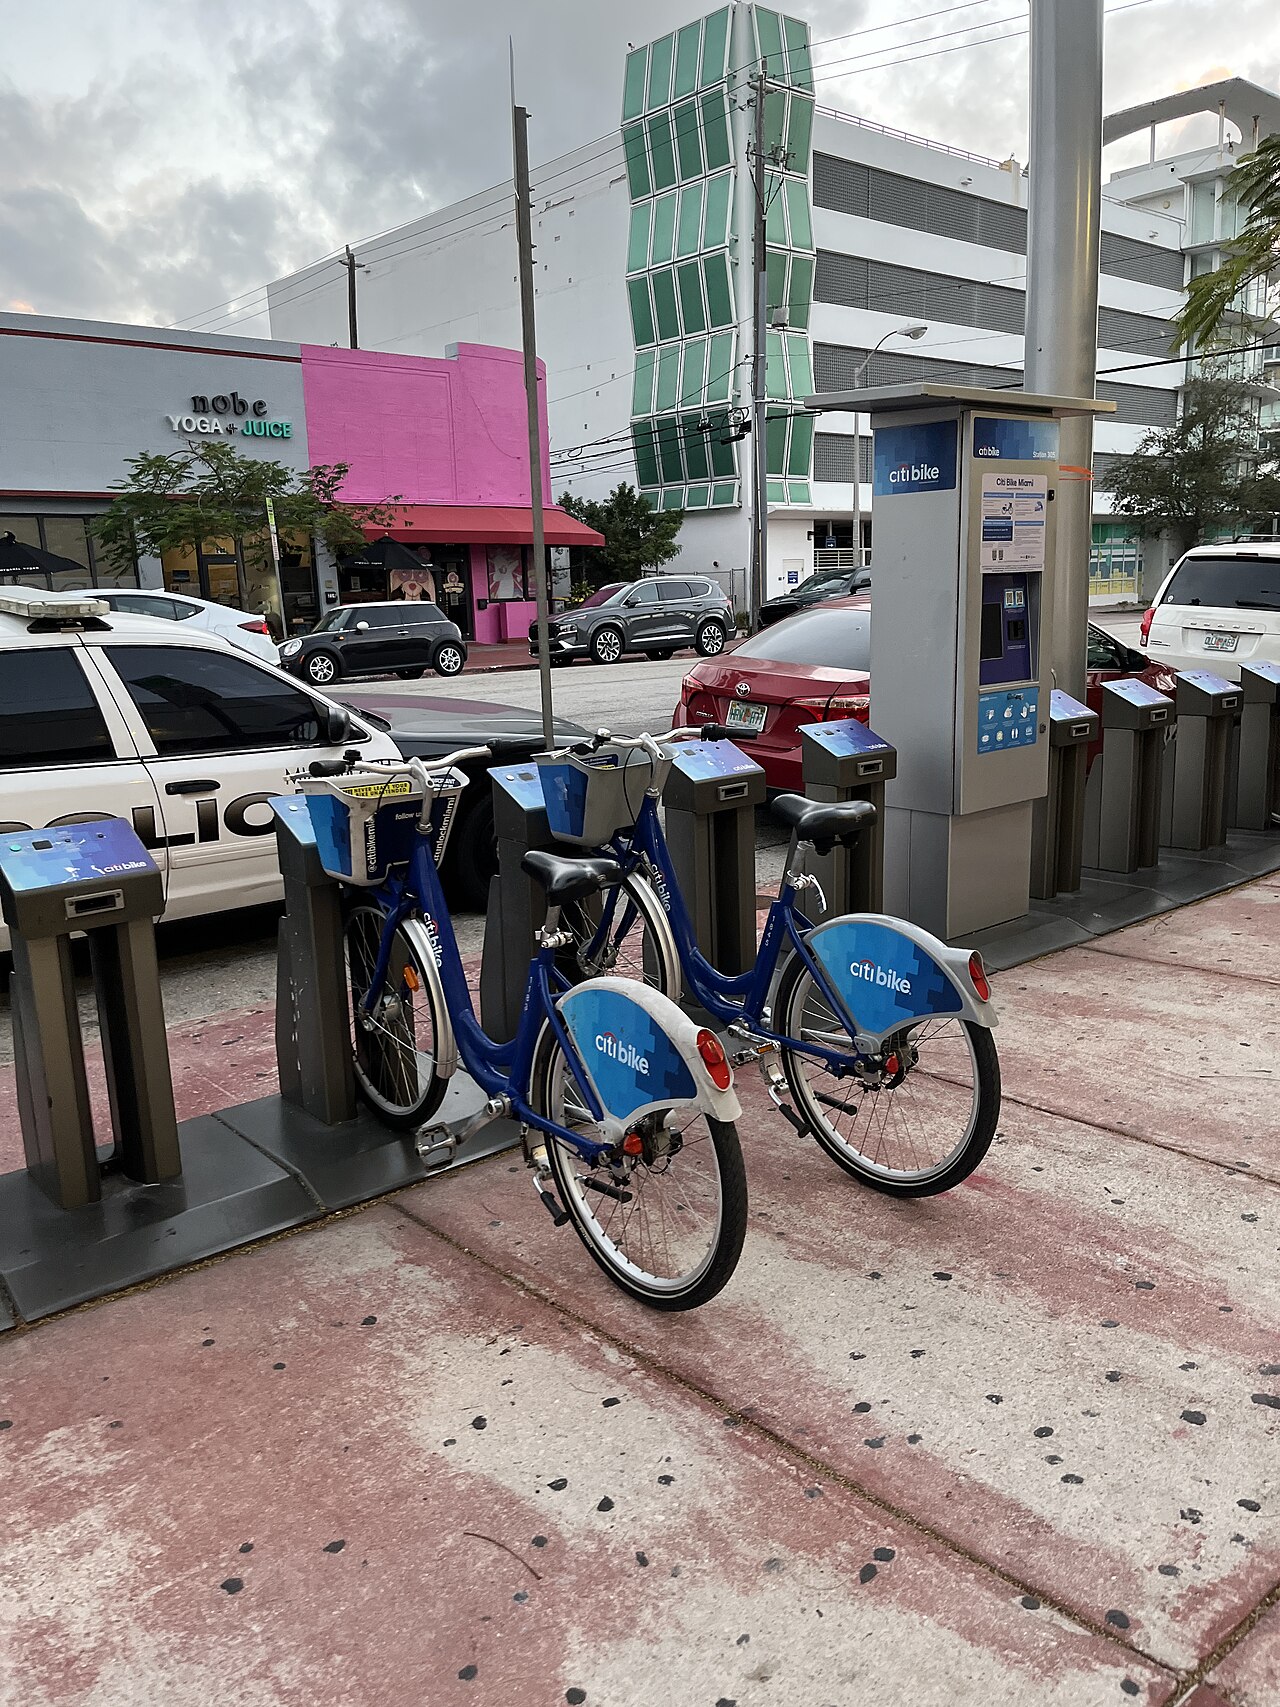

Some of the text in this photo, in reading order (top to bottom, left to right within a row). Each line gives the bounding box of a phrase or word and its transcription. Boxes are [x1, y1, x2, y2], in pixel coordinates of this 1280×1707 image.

[191, 391, 268, 417] nobe
[166, 415, 224, 434] YOGA
[242, 420, 293, 438] JUICE
[1006, 478, 1017, 487] Bike
[1018, 478, 1034, 487] Miami
[370, 787, 407, 796] UNATENDED
[373, 783, 391, 791] LEAE
[395, 813, 415, 821] follow
